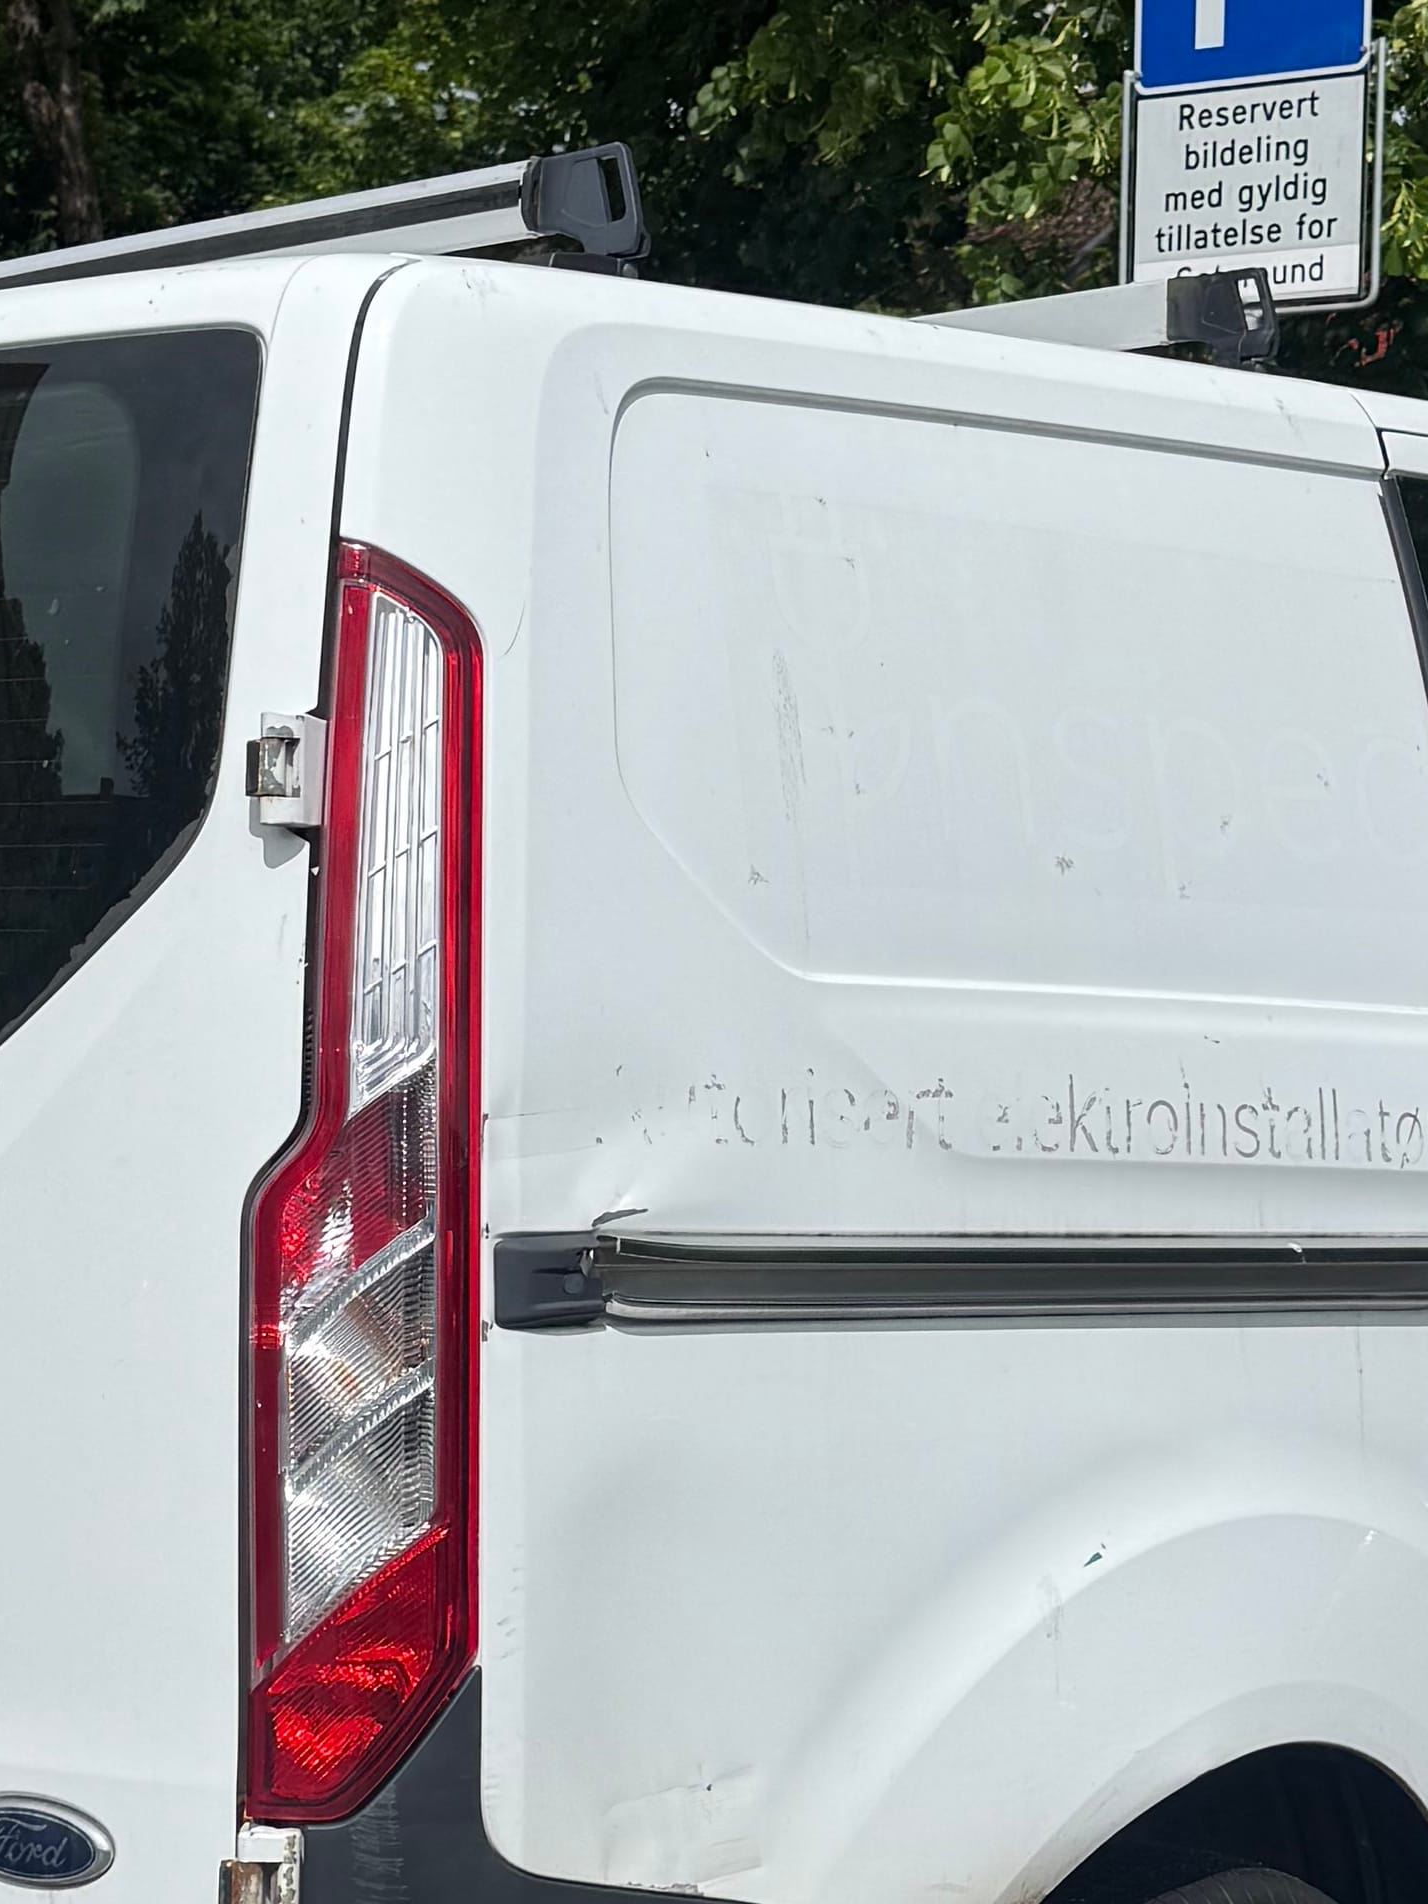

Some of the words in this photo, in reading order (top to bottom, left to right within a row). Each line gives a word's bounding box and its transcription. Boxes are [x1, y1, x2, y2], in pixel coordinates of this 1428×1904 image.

[1178, 90, 1320, 132] Reservert
[1184, 134, 1309, 171] bildeling
[1164, 180, 1223, 212] med
[1237, 172, 1327, 213] gyldig
[1155, 218, 1282, 253] tillatelse
[1296, 212, 1339, 241] for
